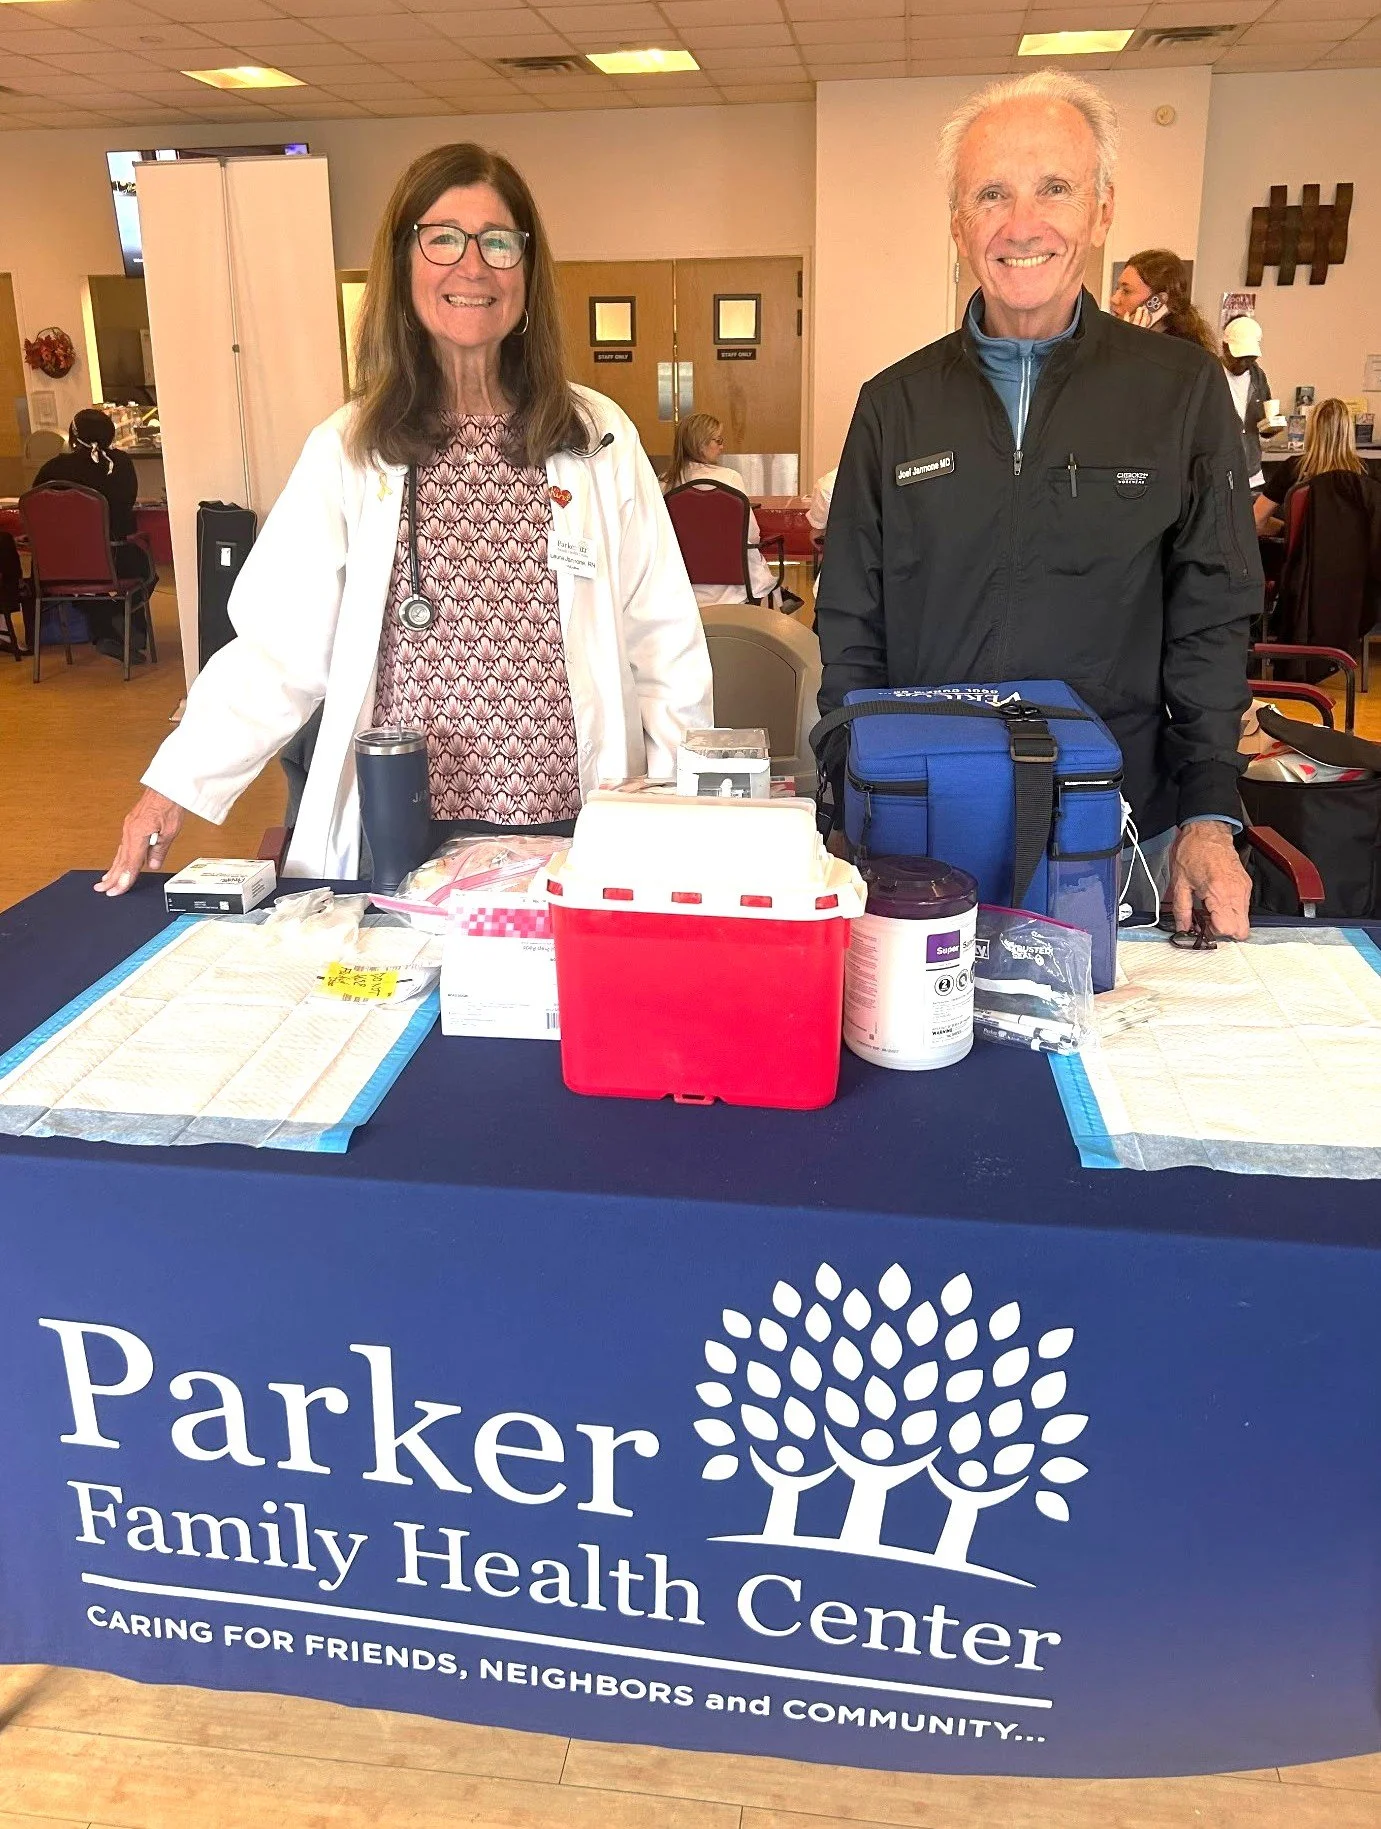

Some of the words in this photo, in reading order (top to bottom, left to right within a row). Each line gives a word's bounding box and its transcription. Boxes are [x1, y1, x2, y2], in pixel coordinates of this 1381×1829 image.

[898, 468, 911, 480] Joel
[940, 457, 950, 468] MD
[936, 944, 960, 956] Super
[39, 1318, 660, 1518] Parker
[67, 1481, 368, 1591] Family
[394, 1522, 706, 1624] Health
[738, 1575, 1062, 1671] Center
[88, 1605, 213, 1644] CARING
[225, 1626, 294, 1656] FOR
[306, 1634, 468, 1680] FRIENDS,
[481, 1658, 694, 1706] NEIGHBORS
[706, 1694, 771, 1716] and
[783, 1700, 1046, 1743] COMMUNITY...
